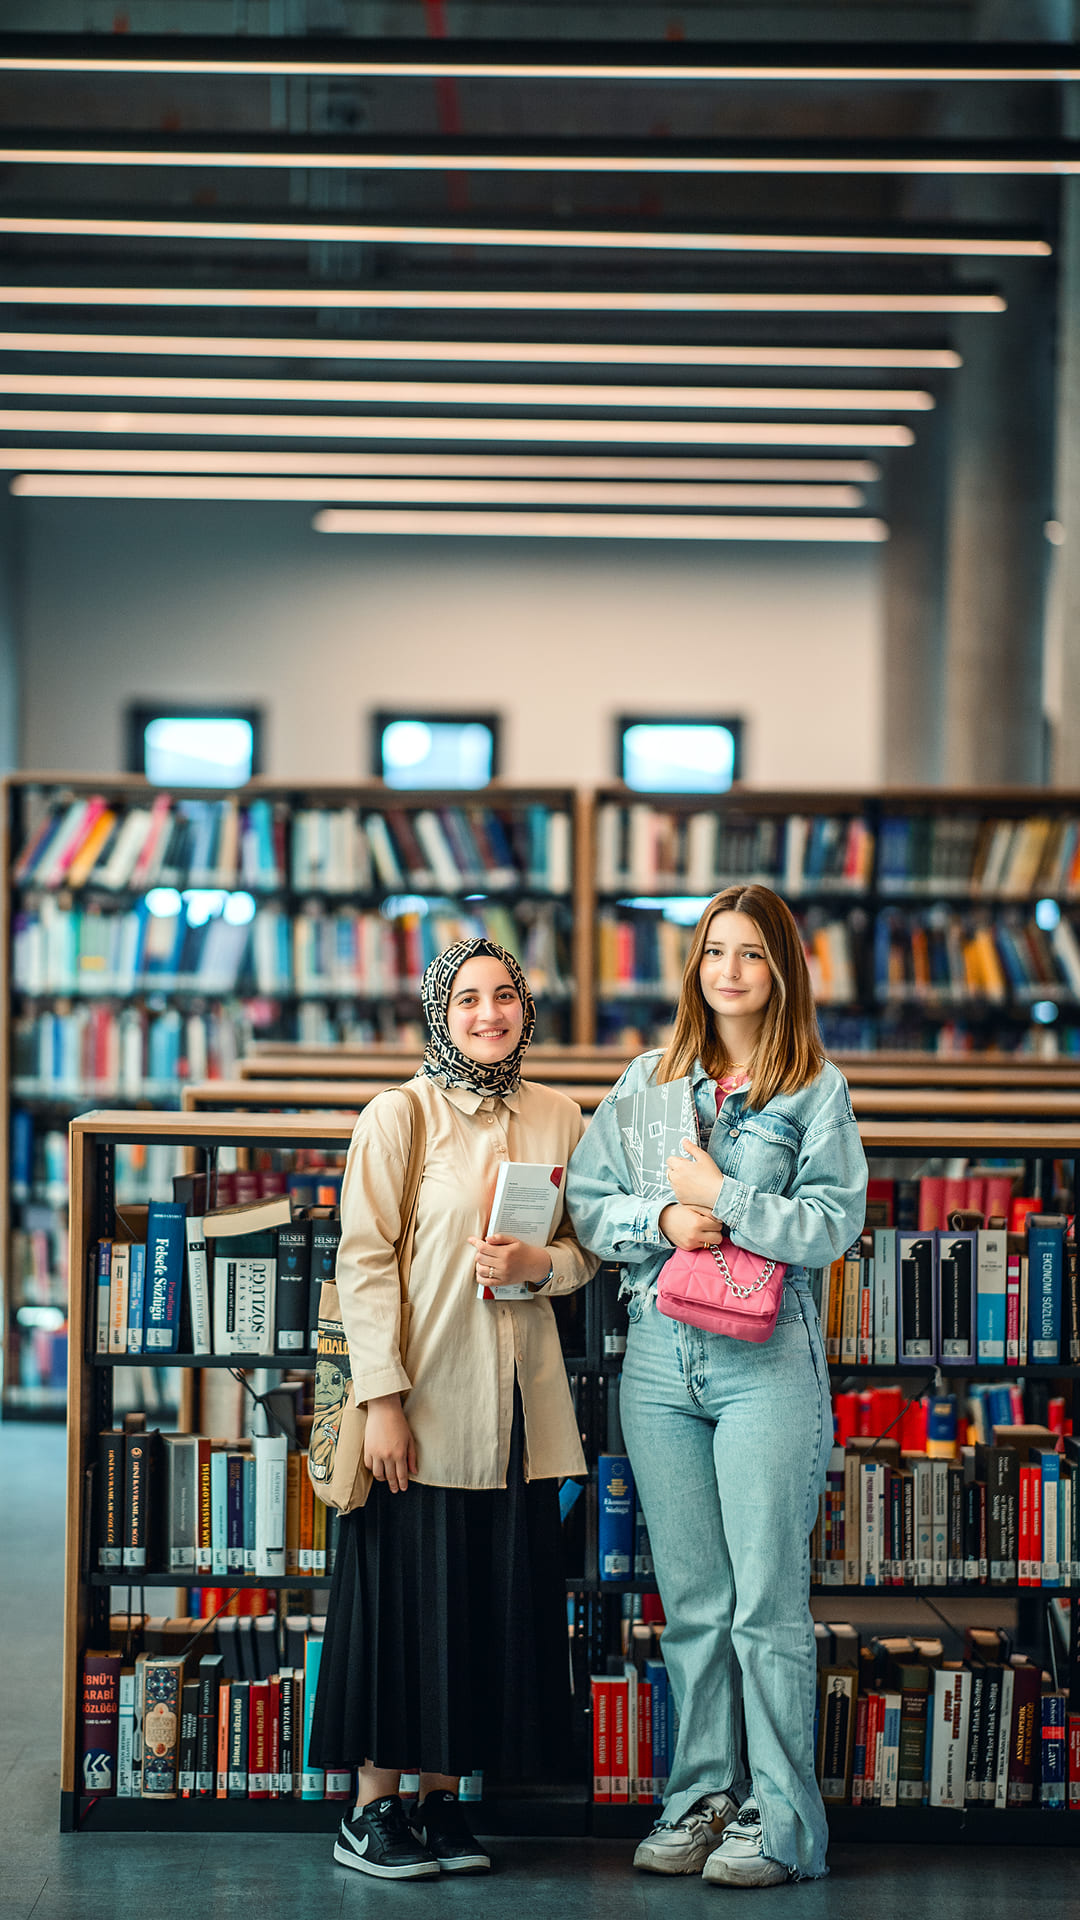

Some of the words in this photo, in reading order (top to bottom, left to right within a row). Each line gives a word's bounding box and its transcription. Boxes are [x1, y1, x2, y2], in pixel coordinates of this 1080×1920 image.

[154, 1238, 170, 1276] Felsefe
[149, 1277, 167, 1321] Sözlüğü
[248, 1263, 266, 1334] SÖZLÜĞÜ
[317, 1337, 349, 1355] NDALO
[131, 1479, 140, 1527] KAVRAMLAR
[201, 1463, 210, 1528] ANSİKLOPEDİSİ
[131, 1528, 139, 1548] SÖZL
[83, 1672, 116, 1685] İBNÜ'L
[83, 1687, 114, 1700] ARABİ
[283, 1681, 291, 1705] TARİH
[82, 1702, 117, 1713] SÖZLÜĞÜ
[234, 1698, 242, 1733] SÖZLÜĞÜ
[256, 1700, 265, 1734] SÖZLÜĞÜ
[283, 1706, 291, 1741] SÖZLÜĞÜ
[232, 1734, 241, 1766] İSİMLER
[256, 1735, 264, 1768] İSİMLER
[1048, 1743, 1059, 1769] Law
